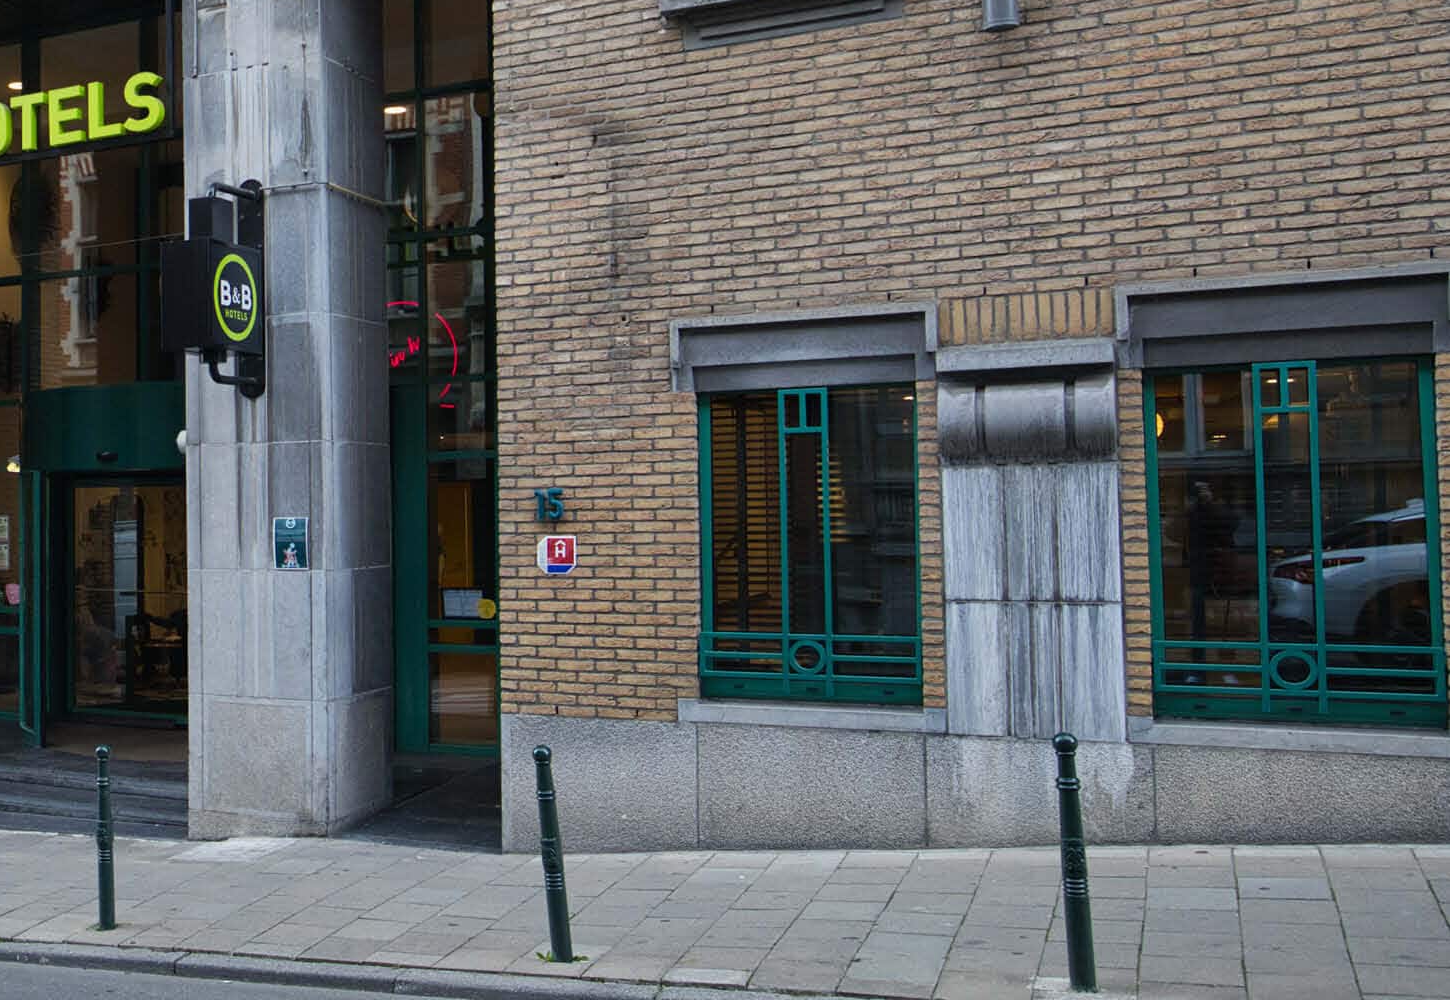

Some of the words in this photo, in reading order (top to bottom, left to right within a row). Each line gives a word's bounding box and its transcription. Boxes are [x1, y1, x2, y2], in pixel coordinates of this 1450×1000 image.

[220, 279, 252, 311] B&B
[224, 308, 248, 321] HOTELS
[534, 487, 563, 520] 15
